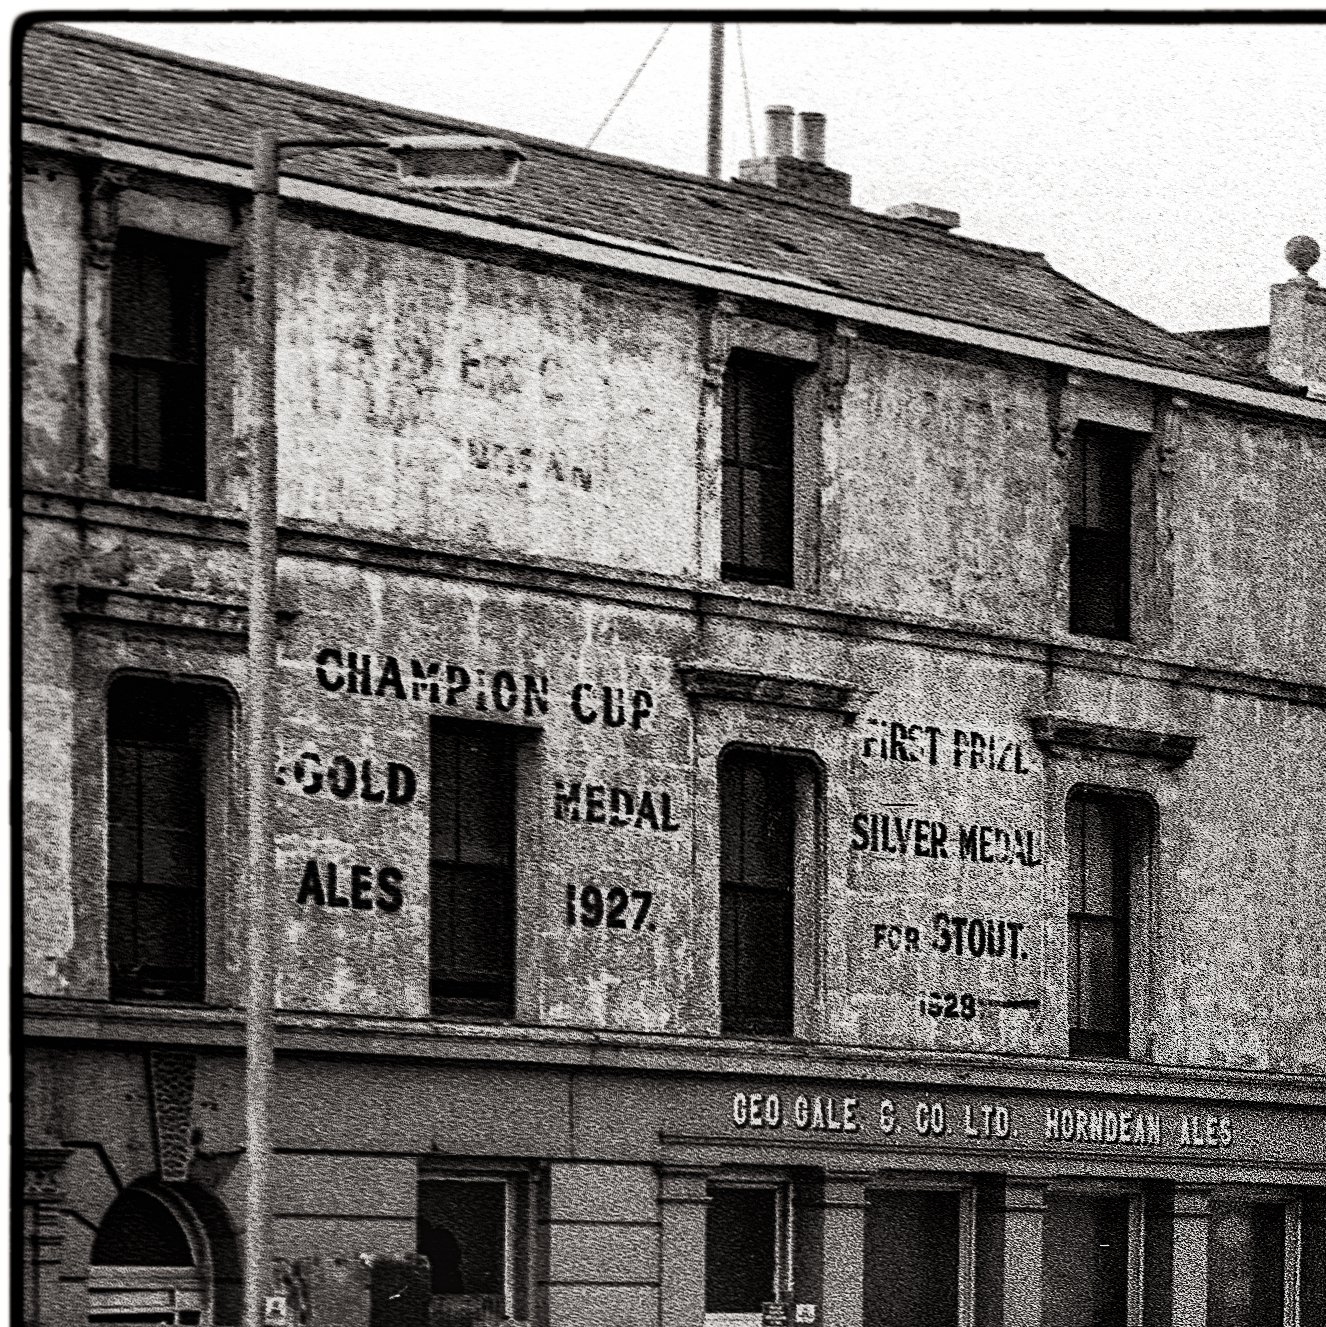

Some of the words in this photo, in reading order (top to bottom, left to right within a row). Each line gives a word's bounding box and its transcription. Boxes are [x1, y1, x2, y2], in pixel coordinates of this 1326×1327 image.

[315, 648, 549, 716] CHAMPION
[570, 682, 654, 731] CUP
[863, 717, 941, 766] FIRST
[952, 729, 1029, 775] PRIZE
[293, 751, 417, 804] GOLD
[555, 781, 681, 832] MEDAL
[851, 813, 948, 860] SILVER
[959, 824, 1042, 867] MEDAL
[297, 860, 404, 913] ALES
[873, 923, 920, 952] FOR
[794, 1095, 861, 1131] GALE
[964, 1104, 1018, 1138] LTD.
[1046, 1107, 1160, 1144] HORNDEAN
[1181, 1115, 1232, 1147] ALES
